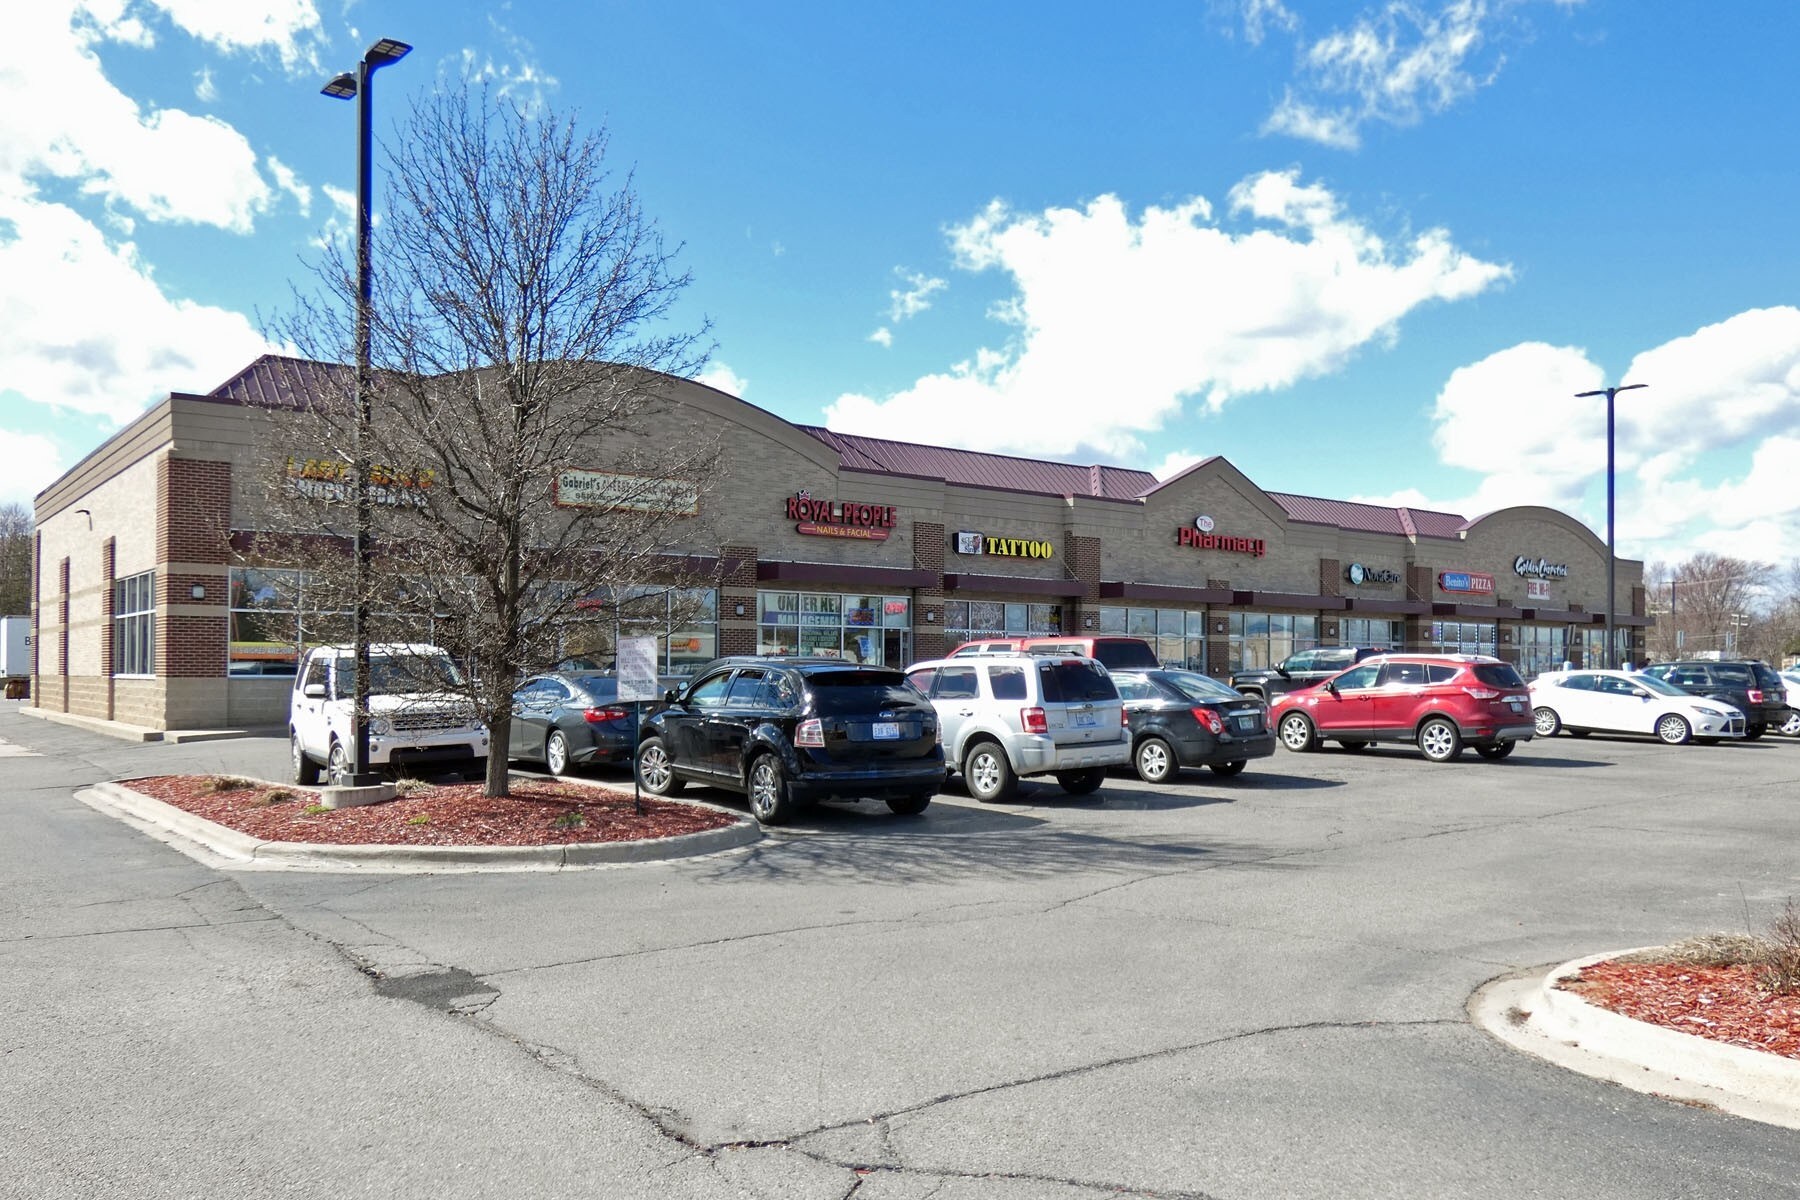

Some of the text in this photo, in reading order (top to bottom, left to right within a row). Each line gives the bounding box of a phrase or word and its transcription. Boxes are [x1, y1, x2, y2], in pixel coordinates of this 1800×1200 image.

[562, 475, 600, 490] Gabriel's
[786, 497, 896, 529] ROYAL PEOPLE
[816, 525, 872, 538] NAILS & FACIAL
[1200, 518, 1212, 528] The
[986, 537, 1053, 559] TATTOO
[1179, 527, 1266, 558] Pharmacy
[1514, 555, 1539, 577] Golden
[1445, 575, 1492, 590] Benito's PIZZA
